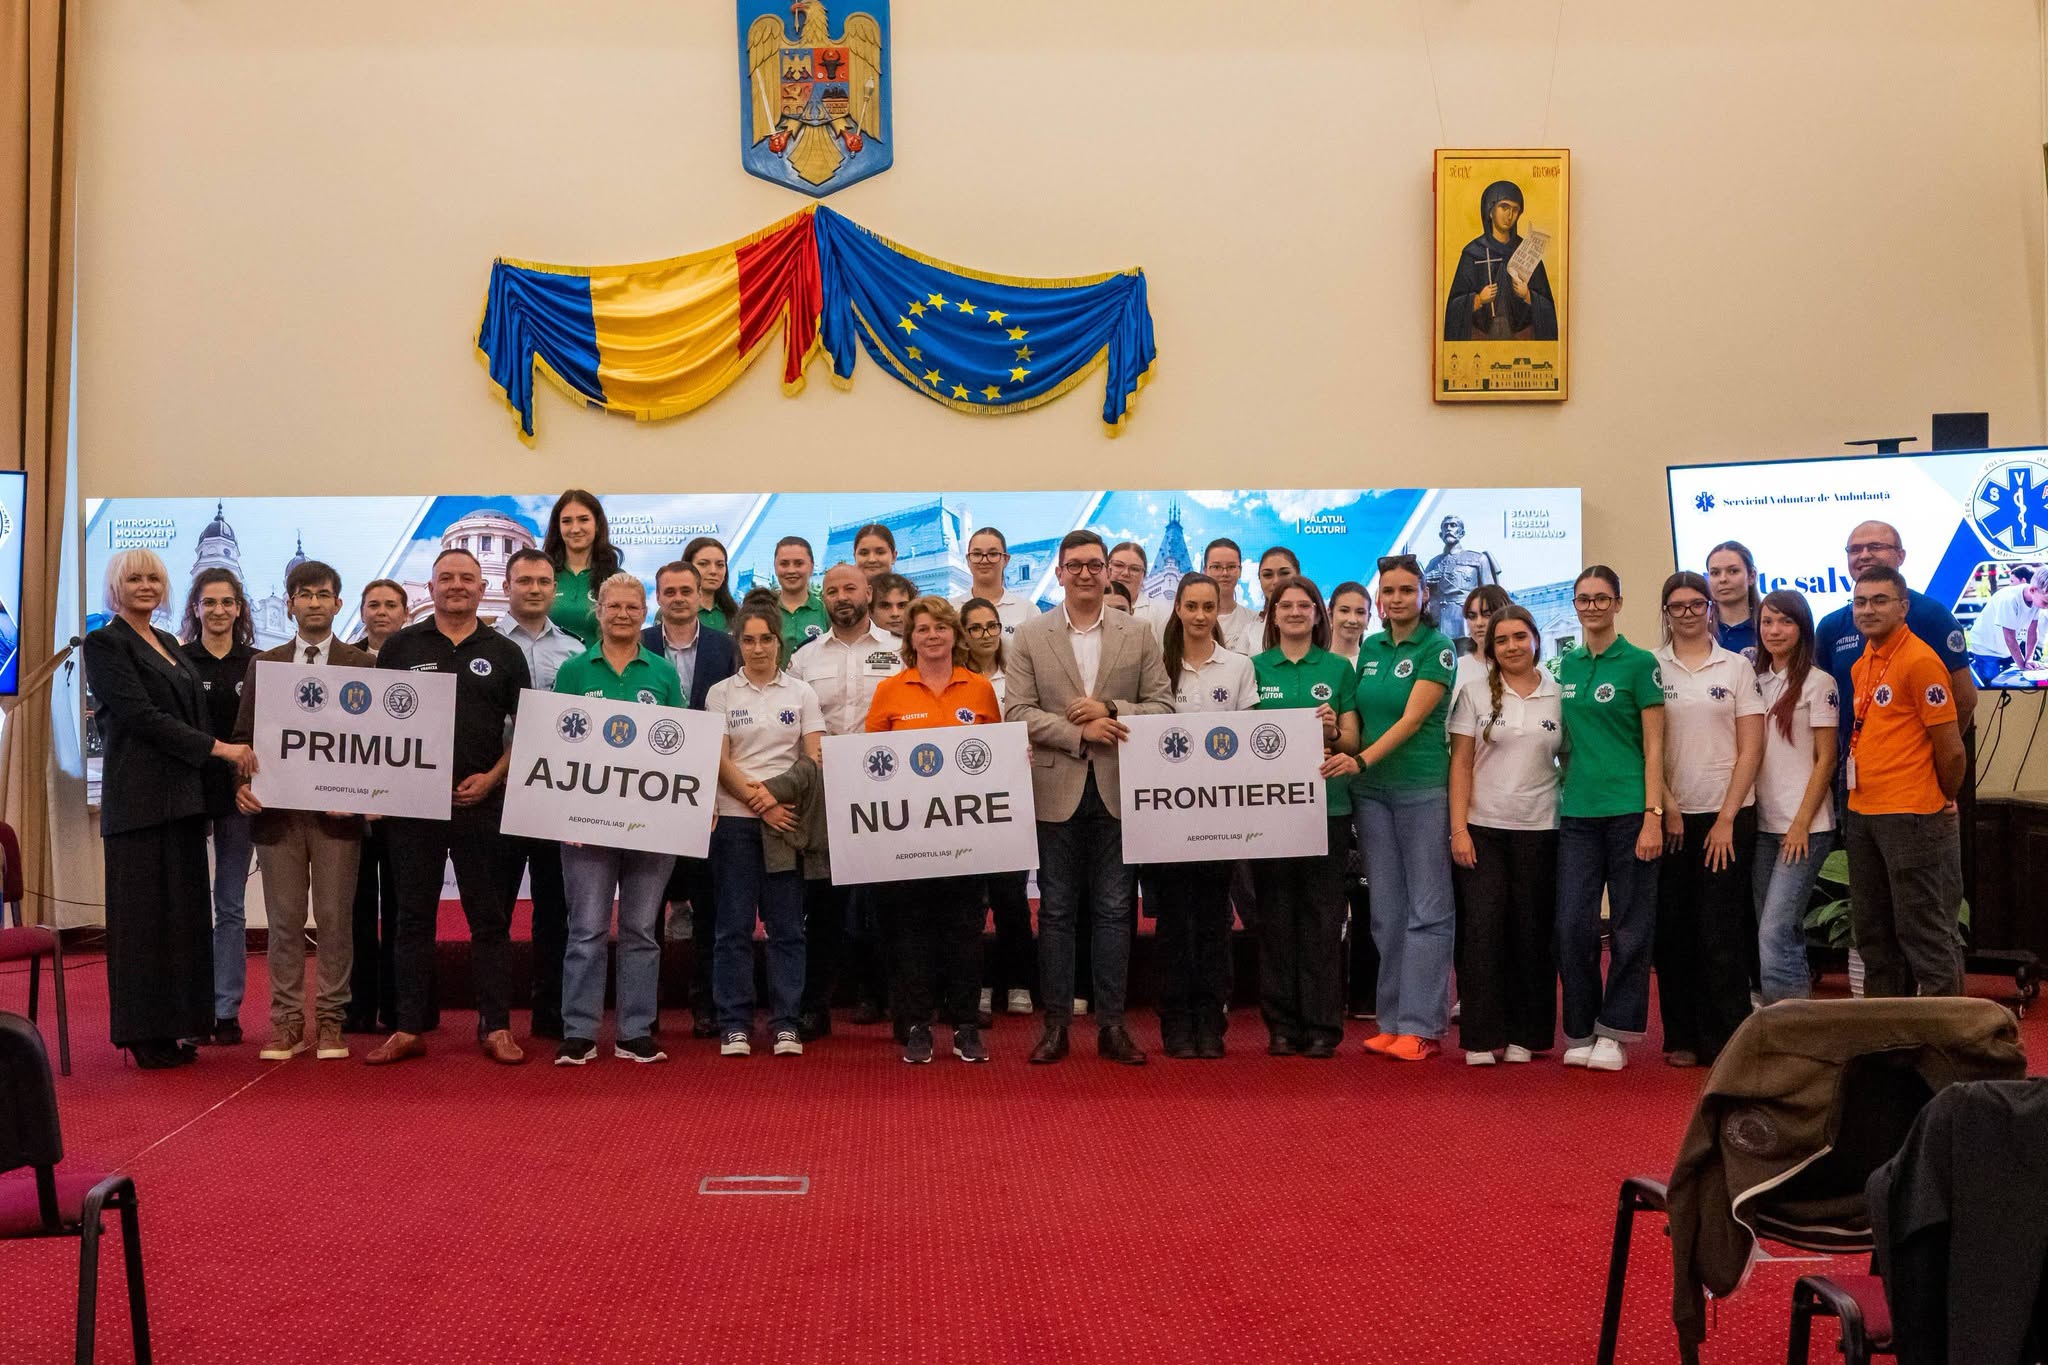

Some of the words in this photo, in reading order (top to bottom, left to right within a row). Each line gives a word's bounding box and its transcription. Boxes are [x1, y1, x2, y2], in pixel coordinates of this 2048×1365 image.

[1723, 496, 1767, 506] Serviciul
[1770, 495, 1816, 504] Voluntar
[1818, 493, 1830, 502] de
[1510, 509, 1549, 518] STATUIA
[115, 519, 174, 528] MITROPOLIA
[607, 515, 653, 524] BLIOTECA
[1304, 515, 1345, 524] PALATUL
[1510, 519, 1549, 528] REGELUI
[610, 523, 648, 534] NTRALĂ
[650, 522, 719, 534] UNIVERSITARĂ
[1304, 525, 1347, 534] CULTURII
[115, 529, 165, 538] MOLDOVEI
[1510, 530, 1566, 538] FERDINAND
[115, 539, 168, 549] BUCOVINEI
[1795, 567, 1853, 593] salv
[1664, 691, 1678, 699] TOR
[731, 709, 749, 718] PRIM
[901, 712, 929, 721] ASISTENT
[280, 729, 437, 769] PRIMUL
[524, 757, 701, 807] AJUTOR
[315, 785, 356, 794] AEROPORTUL
[1134, 782, 1315, 811] FRONTIERE!
[850, 799, 910, 834] NU
[923, 791, 1013, 829] ARE
[568, 816, 611, 826] AEROPORTUL
[895, 852, 938, 860] AEROPORTUL
